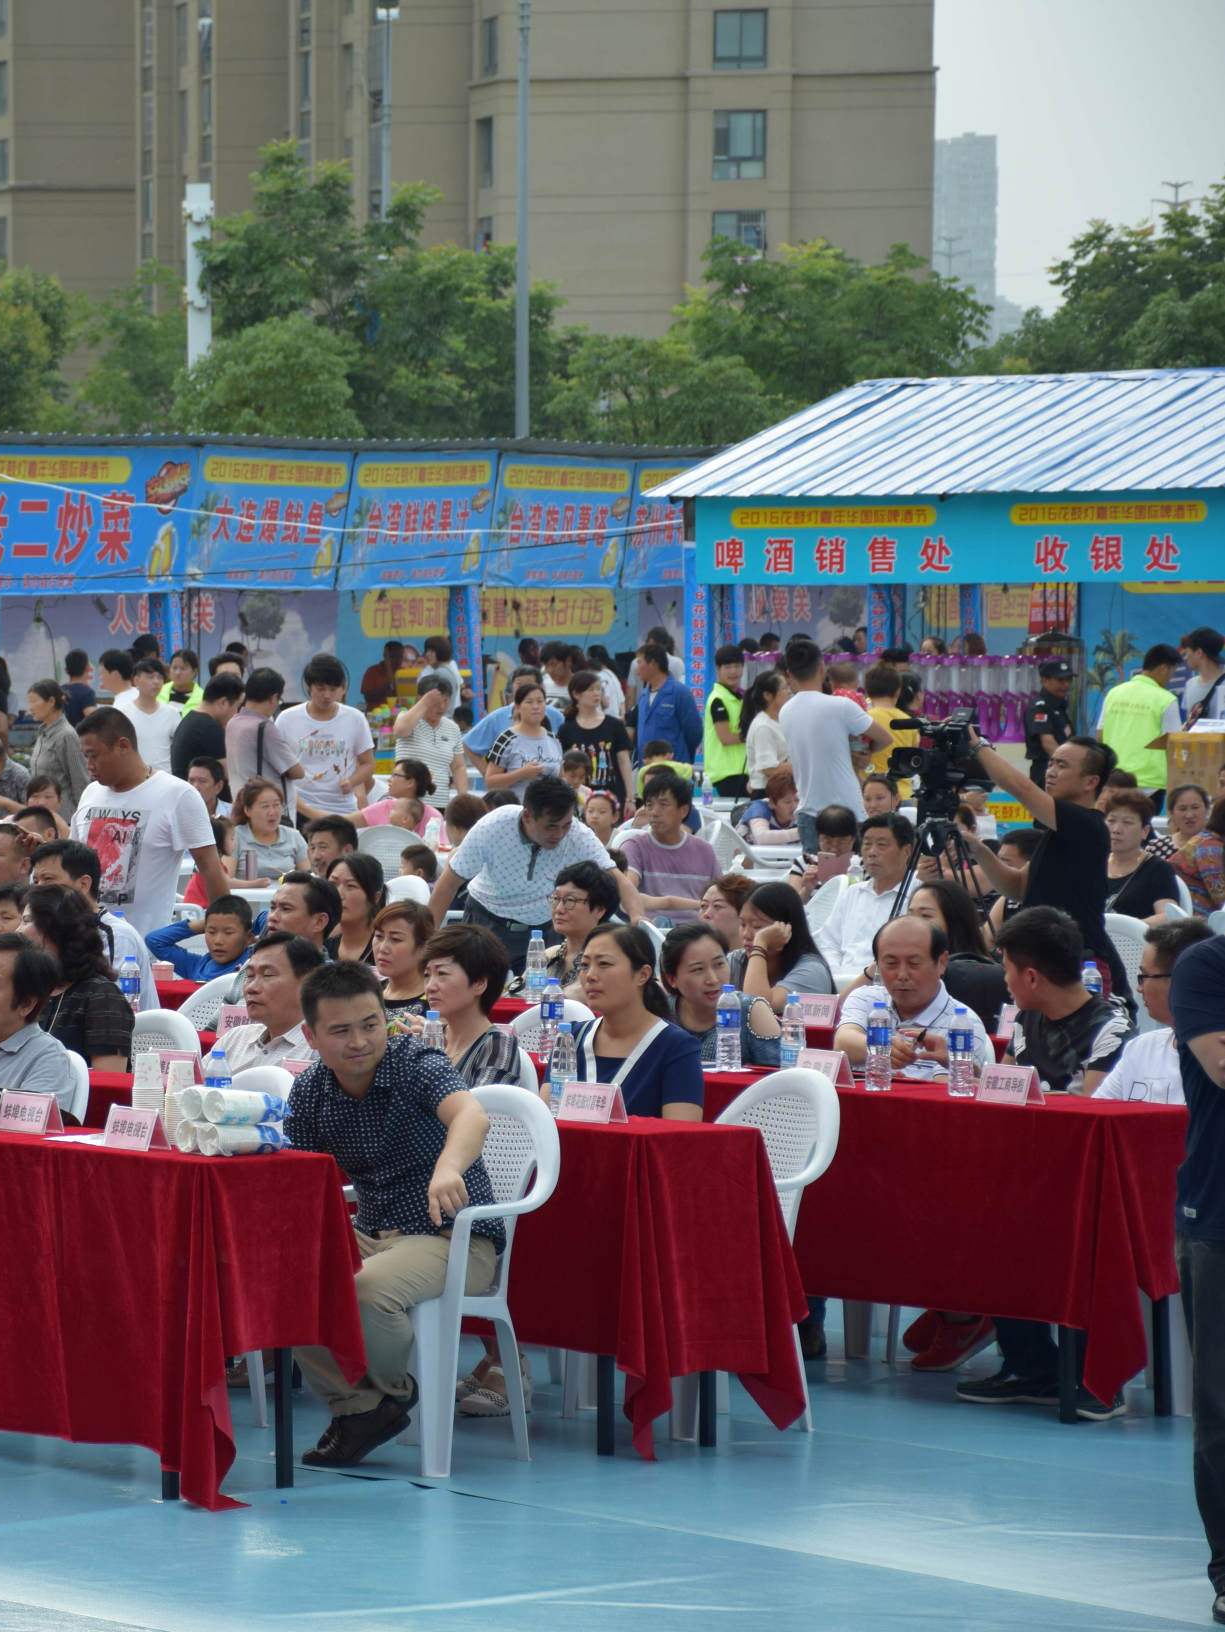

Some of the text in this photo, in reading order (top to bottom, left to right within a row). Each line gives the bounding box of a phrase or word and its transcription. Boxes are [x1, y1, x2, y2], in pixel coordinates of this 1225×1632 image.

[212, 498, 325, 545] 大连爆鱿鱼
[366, 500, 470, 545] 台湾鲜榨果汁
[714, 536, 952, 575] 啤酒销售处
[1033, 533, 1180, 574] 收银处
